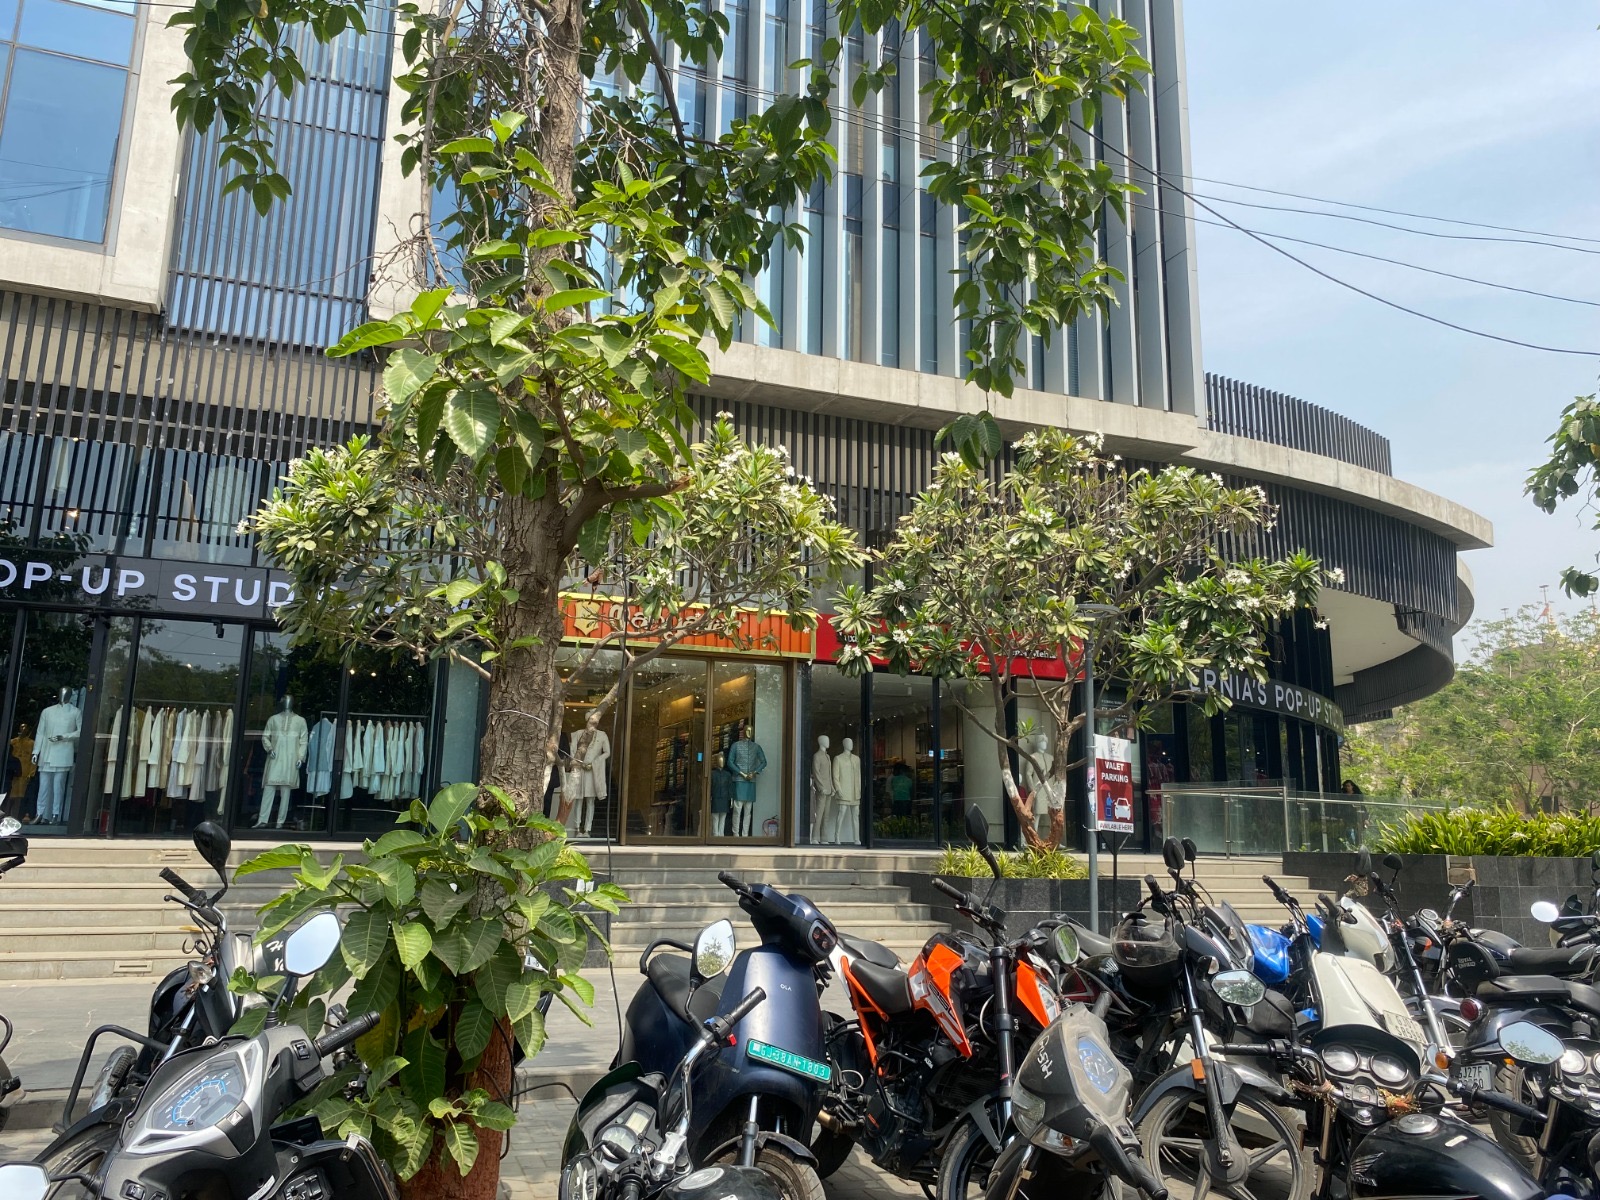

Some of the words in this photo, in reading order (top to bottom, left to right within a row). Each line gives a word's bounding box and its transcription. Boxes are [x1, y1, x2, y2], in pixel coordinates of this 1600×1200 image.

[1171, 665, 1267, 706] ERNIA'S
[1275, 684, 1322, 719] POP-UP
[1104, 760, 1125, 772] VALET
[1101, 772, 1129, 783] PARKING
[1100, 822, 1121, 831] AVAILABLE
[1121, 824, 1133, 832] HERE
